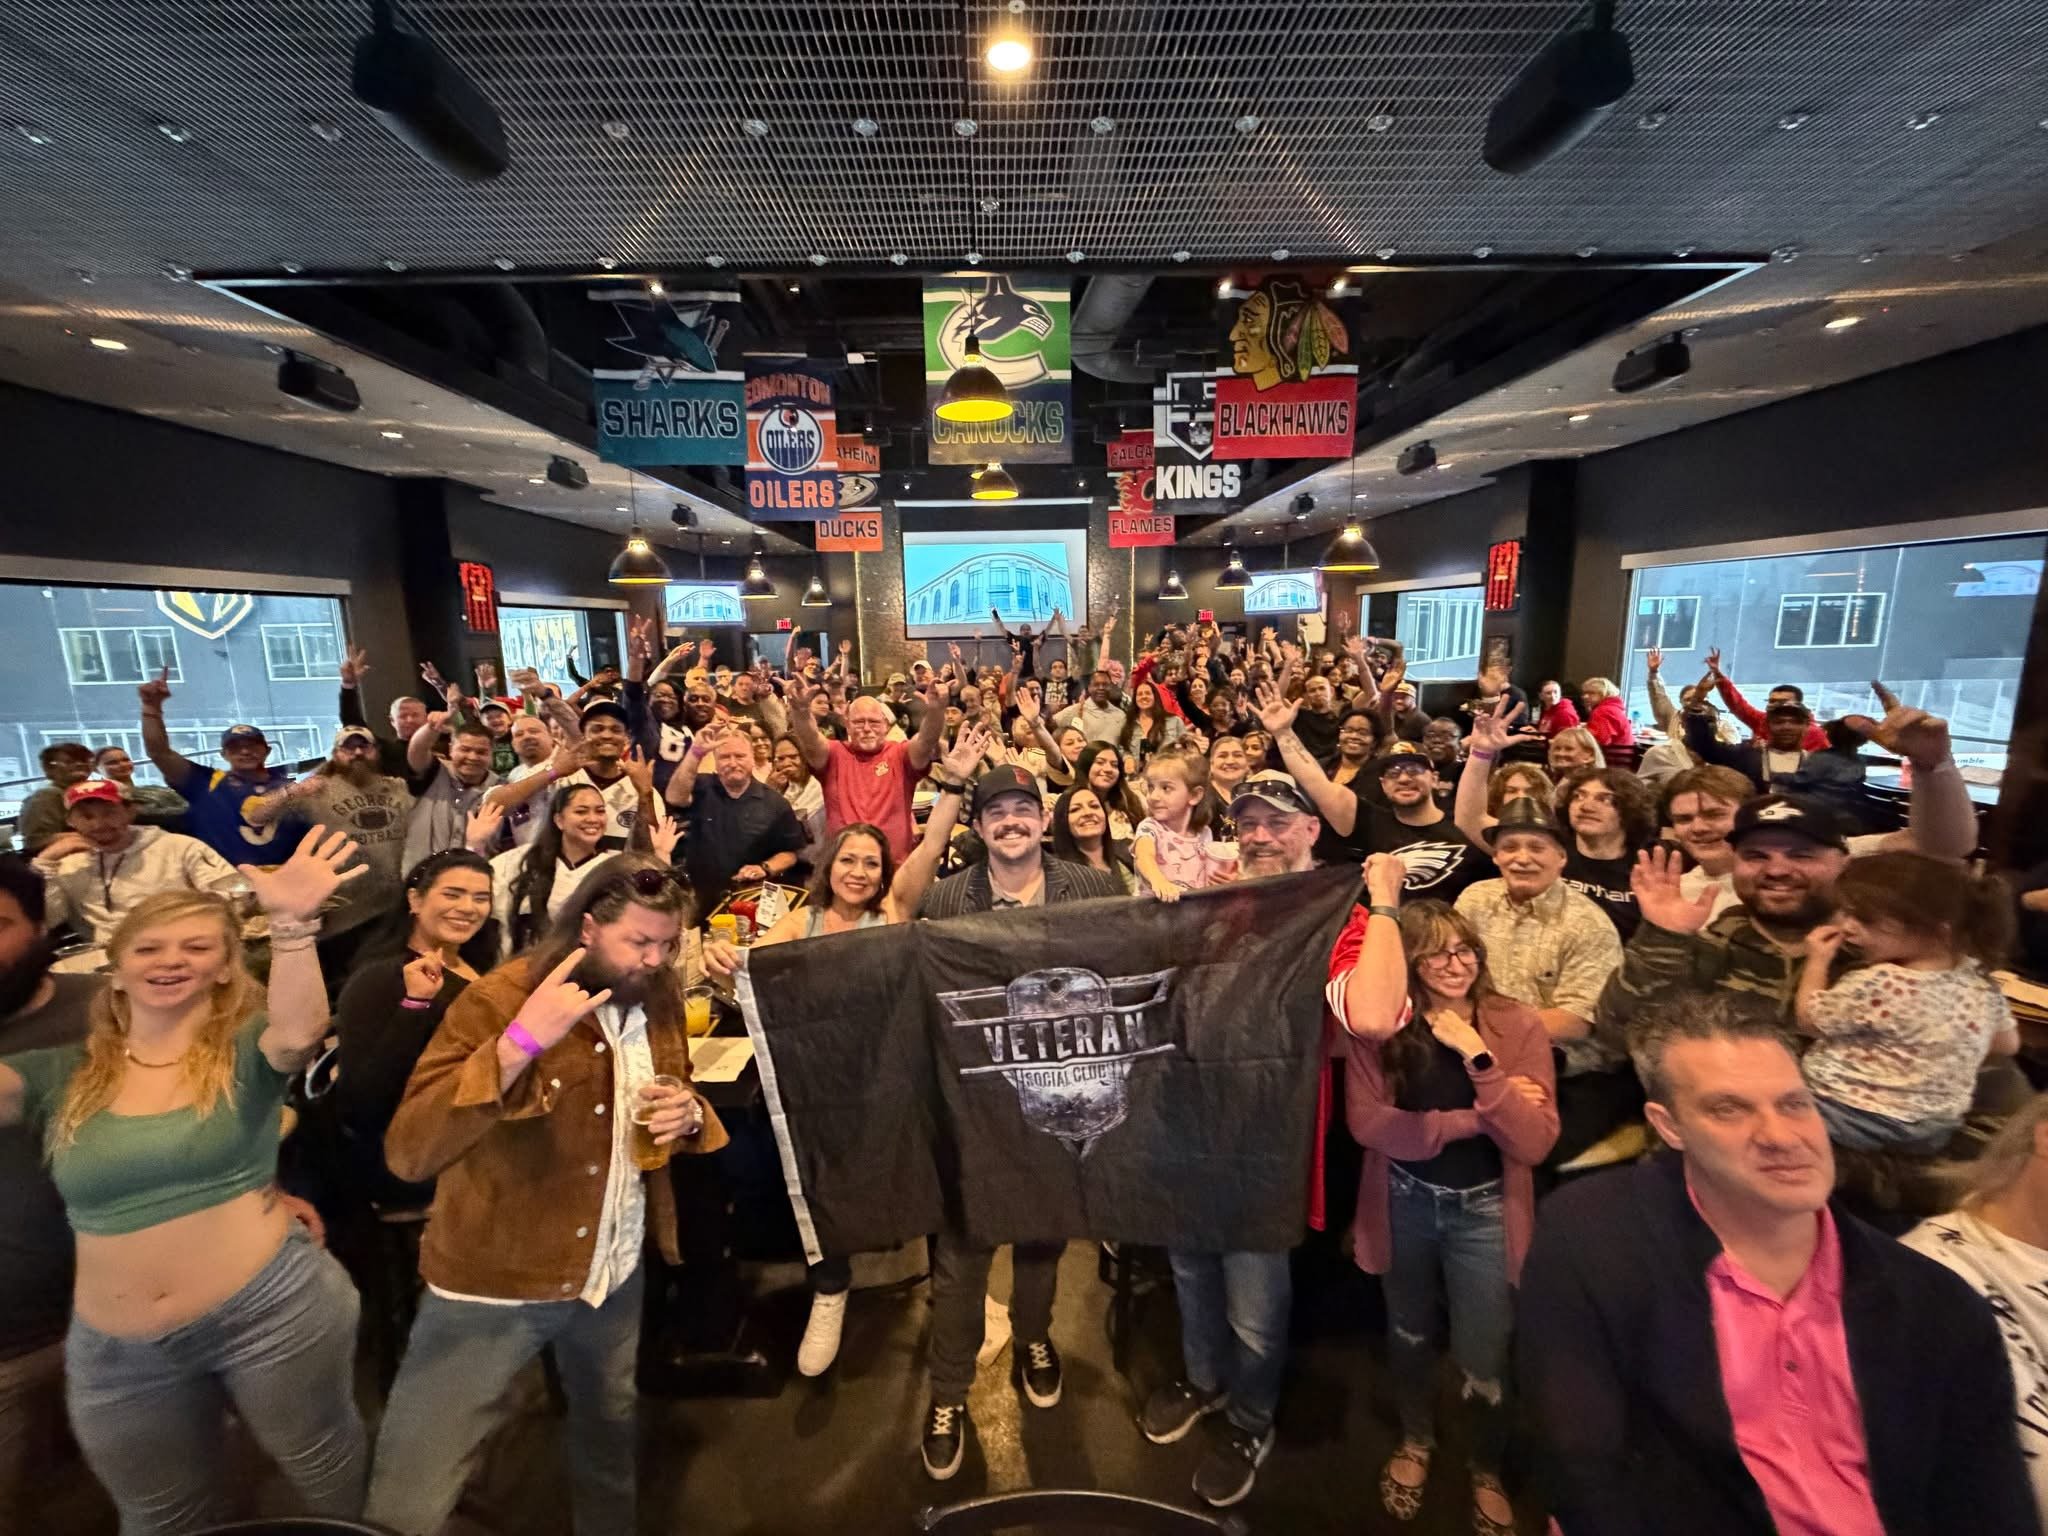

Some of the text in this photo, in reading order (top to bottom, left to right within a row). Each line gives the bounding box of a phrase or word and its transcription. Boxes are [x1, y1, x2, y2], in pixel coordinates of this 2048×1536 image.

[745, 373, 832, 408] EDMONTON
[601, 398, 740, 439] SHARKS
[1218, 400, 1350, 438] BLACKHAWKS
[765, 429, 816, 449] OILERS
[749, 480, 835, 508] OILERS
[1155, 464, 1241, 499] KINGS
[818, 519, 879, 539] DUCKS
[1111, 517, 1173, 534] FLAMES
[983, 1011, 1148, 1063] VETERAN
[1025, 1070, 1072, 1088] SOCIAL
